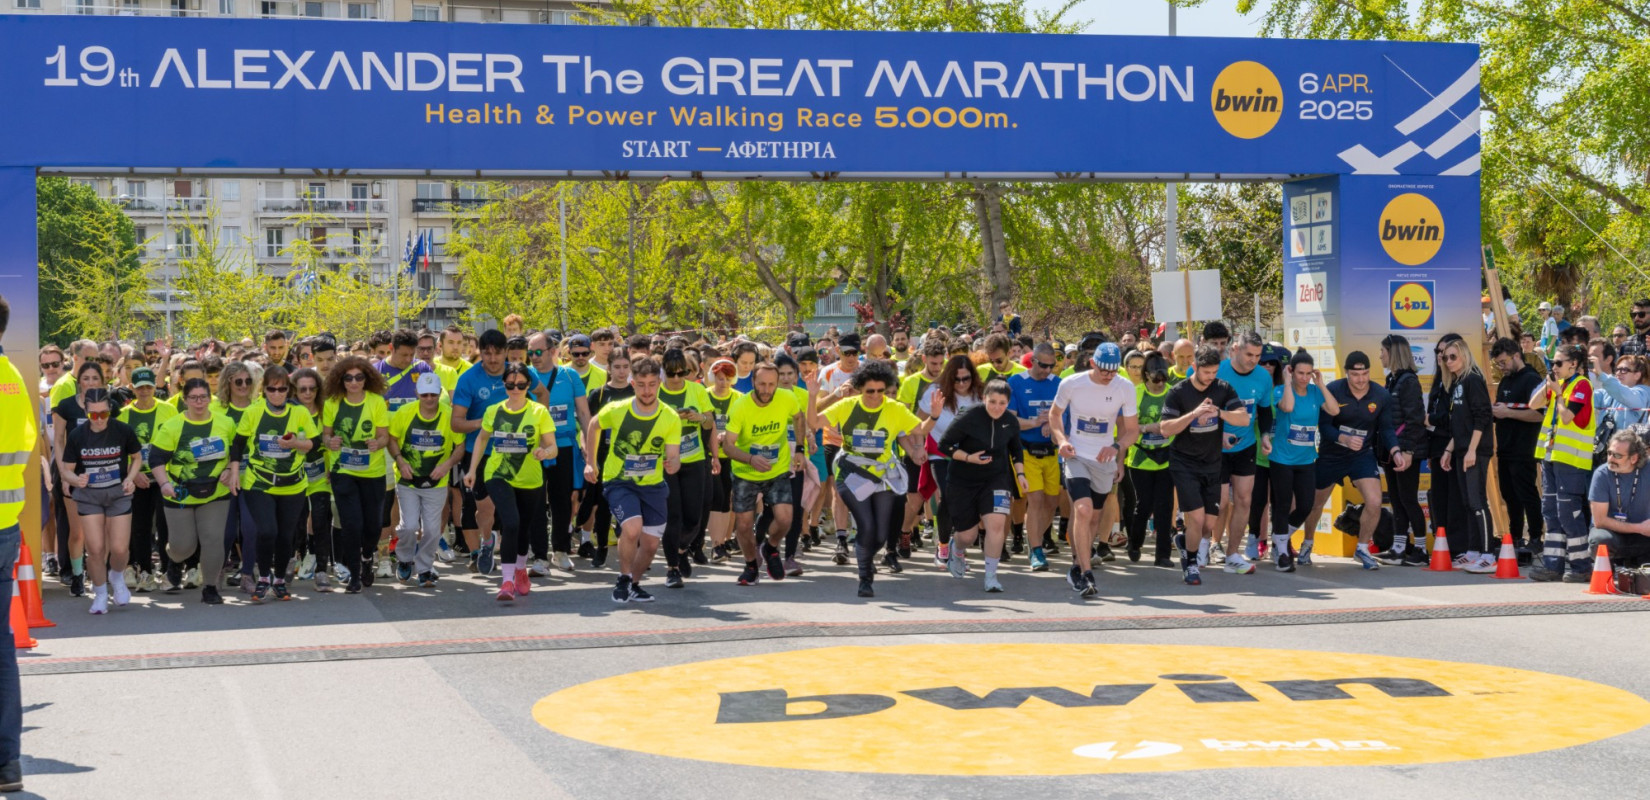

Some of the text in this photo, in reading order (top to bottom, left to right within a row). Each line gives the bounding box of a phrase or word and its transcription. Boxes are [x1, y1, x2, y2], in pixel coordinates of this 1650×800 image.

[150, 48, 524, 93] ALEXANDER
[543, 54, 644, 95] The
[661, 56, 853, 97] GREAT
[866, 59, 1194, 102] MARATHON
[1299, 72, 1373, 94] 6 APR.
[1214, 87, 1278, 112] bwin
[1299, 99, 1373, 121] 2025
[425, 102, 1018, 132] Health & Power Walking Race 5.000m.
[622, 140, 691, 158] START
[725, 141, 837, 159] ΑΦΕΤΗΡΙΑ
[1381, 218, 1440, 241] bwin
[752, 420, 780, 434] bwin
[80, 445, 121, 456] COSMOS
[716, 674, 1455, 723] bwin
